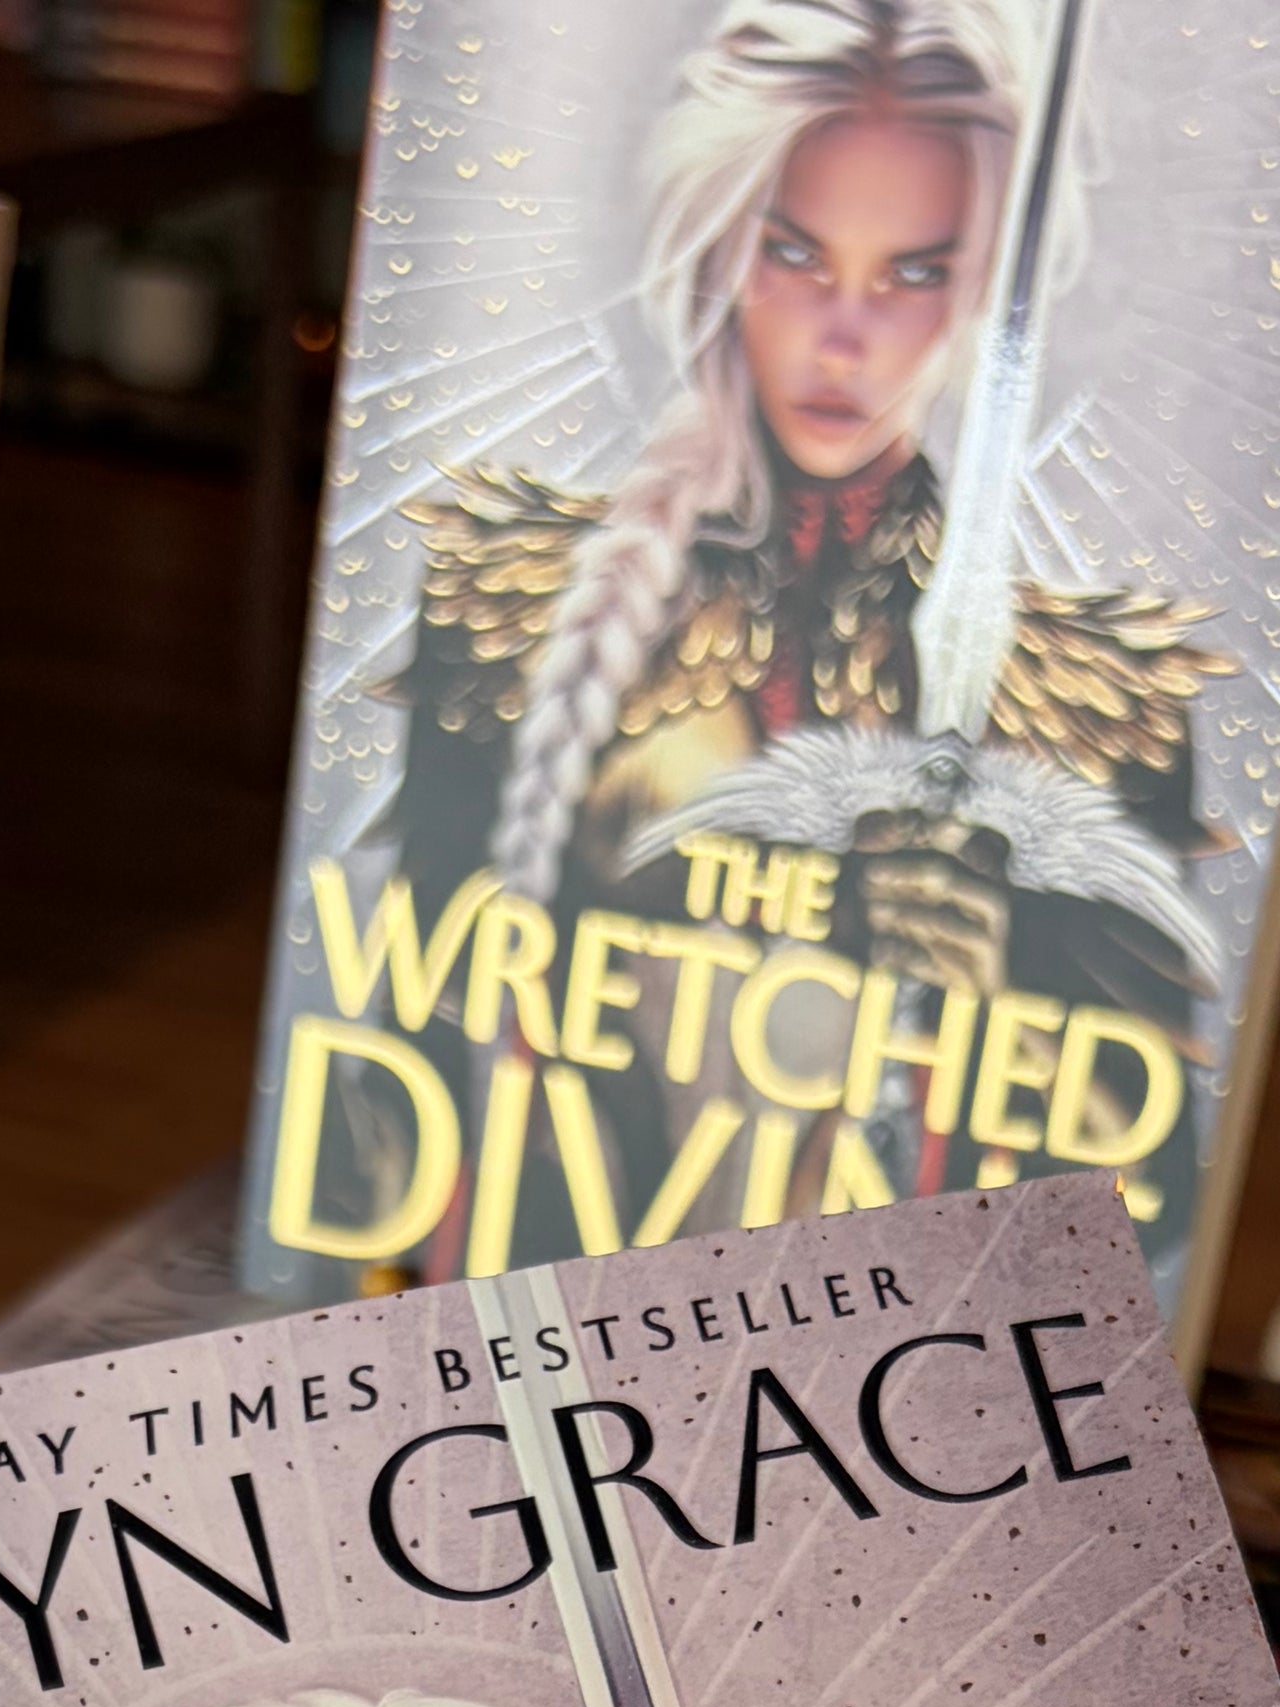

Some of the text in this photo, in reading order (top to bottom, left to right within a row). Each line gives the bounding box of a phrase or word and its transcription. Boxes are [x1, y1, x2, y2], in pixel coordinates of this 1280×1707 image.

[675, 834, 841, 942] THE
[309, 855, 1186, 1169] WRETCHED
[129, 1364, 380, 1457] TIMES
[434, 1265, 914, 1395] BESTSELLER
[367, 1311, 1133, 1603] GRACE
